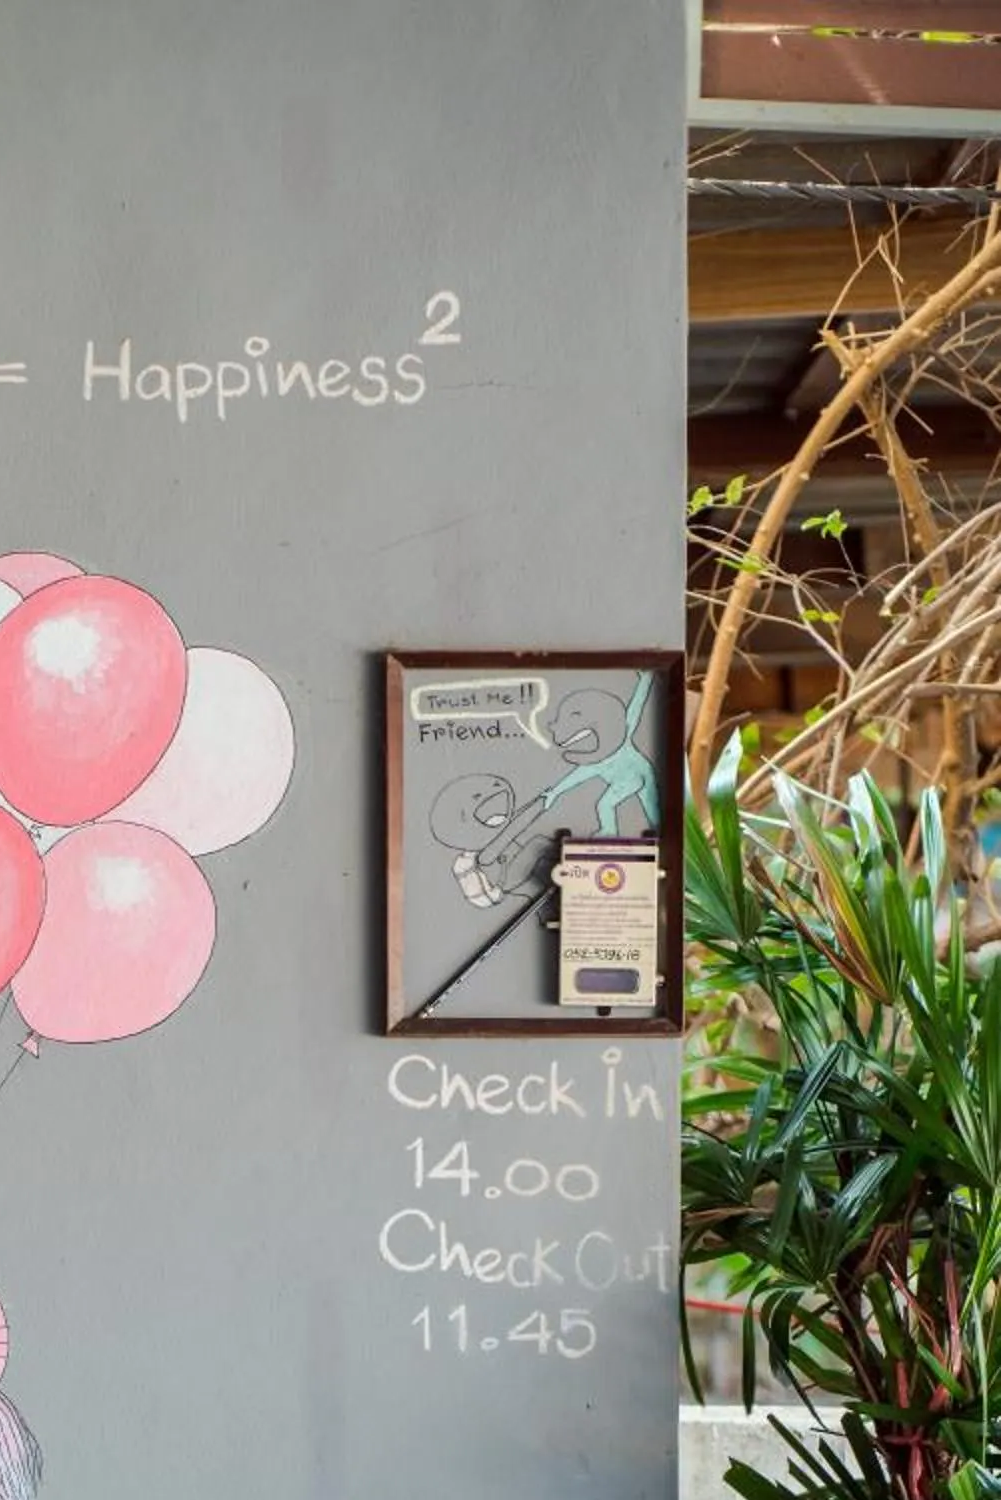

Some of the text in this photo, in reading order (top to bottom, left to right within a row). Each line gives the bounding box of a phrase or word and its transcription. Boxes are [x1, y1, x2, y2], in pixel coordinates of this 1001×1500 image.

[84, 336, 426, 423] Happiness
[427, 694, 476, 709] Trust
[388, 1054, 587, 1118] Check
[405, 1136, 599, 1201] 14.00
[379, 1208, 672, 1294] Check Out
[410, 1304, 597, 1358] 11.45
